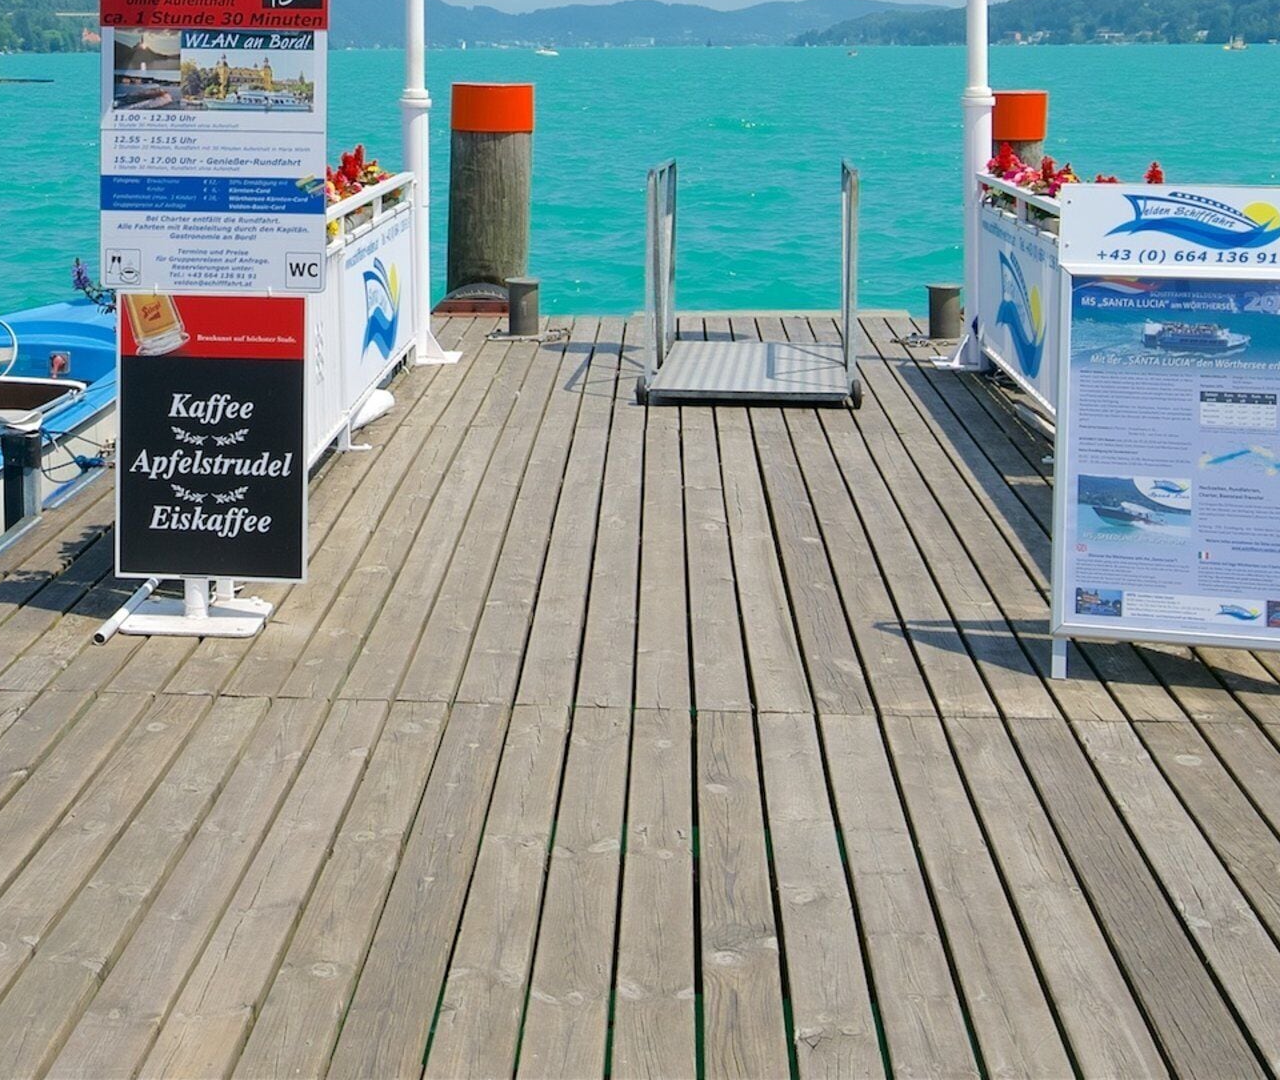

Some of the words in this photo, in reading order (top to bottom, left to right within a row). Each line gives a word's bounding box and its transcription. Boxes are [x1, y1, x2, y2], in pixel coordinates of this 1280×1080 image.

[103, 12, 124, 25] ca.
[135, 11, 145, 24] 1
[151, 11, 216, 26] Stunde
[220, 12, 244, 26] 30
[249, 12, 323, 27] Minuten
[185, 33, 239, 48] WLAN
[243, 36, 262, 49] an
[269, 33, 312, 50] Bord!
[114, 114, 140, 122] 11.00
[150, 114, 177, 122] 12.30
[179, 114, 197, 122] Uhr
[150, 136, 177, 144] 15.15
[179, 136, 197, 145] Uhr
[114, 156, 141, 164] 15.30
[150, 156, 177, 165] 17.00
[179, 157, 197, 165] Uhr
[206, 157, 302, 167] Genießer-Rundfahrt
[1096, 249, 1132, 261] +43
[1138, 249, 1166, 264] (0)
[1174, 250, 1207, 262] 664
[1215, 251, 1249, 263] 136
[1256, 252, 1277, 264] 91
[289, 262, 318, 278] WC
[1081, 297, 1096, 307] MS
[1090, 354, 1106, 363] Mit
[1107, 355, 1121, 365] der
[1197, 358, 1213, 368] den
[1215, 359, 1266, 370] Wörthersee
[168, 393, 254, 424] Kaffee
[129, 449, 293, 480] Apfelstrudel
[149, 505, 272, 538] Eiskaffee
